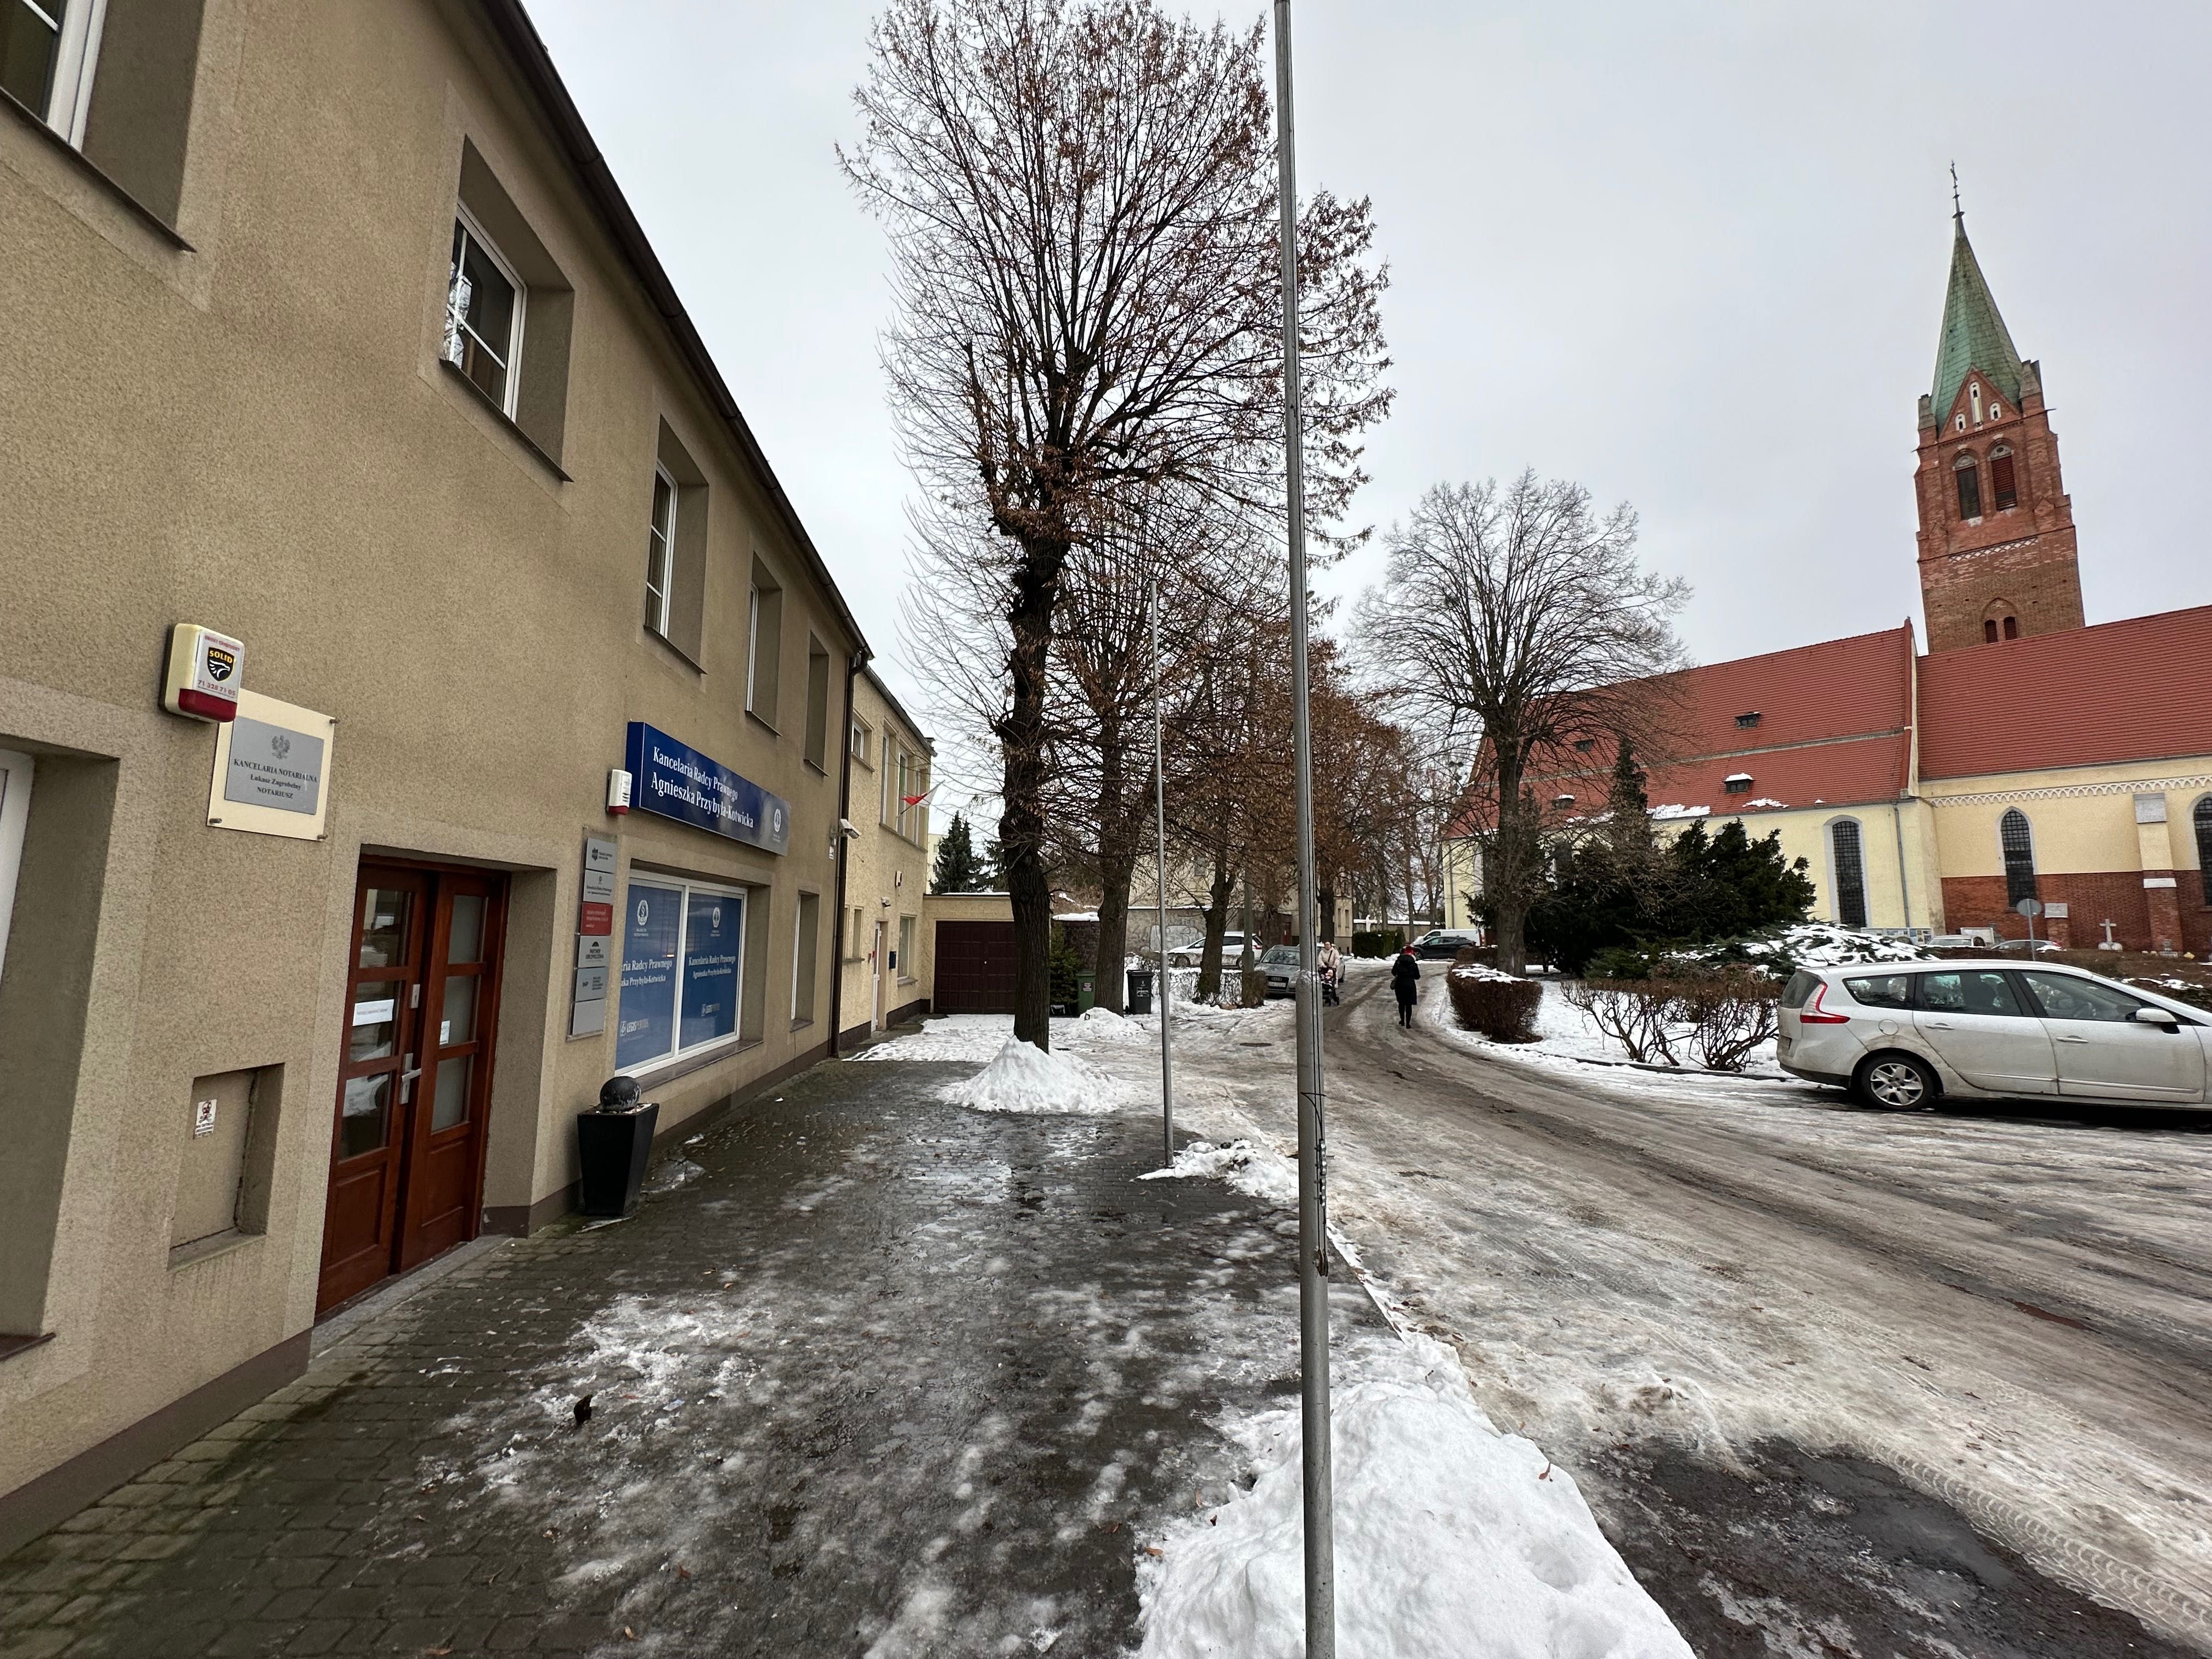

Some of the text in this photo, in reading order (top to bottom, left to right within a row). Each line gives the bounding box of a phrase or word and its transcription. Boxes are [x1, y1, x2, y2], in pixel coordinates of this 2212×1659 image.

[209, 650, 233, 663] SOLID
[234, 759, 318, 783] KANCELARIA NOTARIALNA
[653, 746, 738, 803] Kancelaria Radcy Prawnego
[257, 787, 294, 799] NOTARIUSZ
[651, 772, 754, 828] Agnieszka Przybyła-Kotwicka
[631, 960, 648, 972] Radcy
[648, 959, 673, 970] Prawnego
